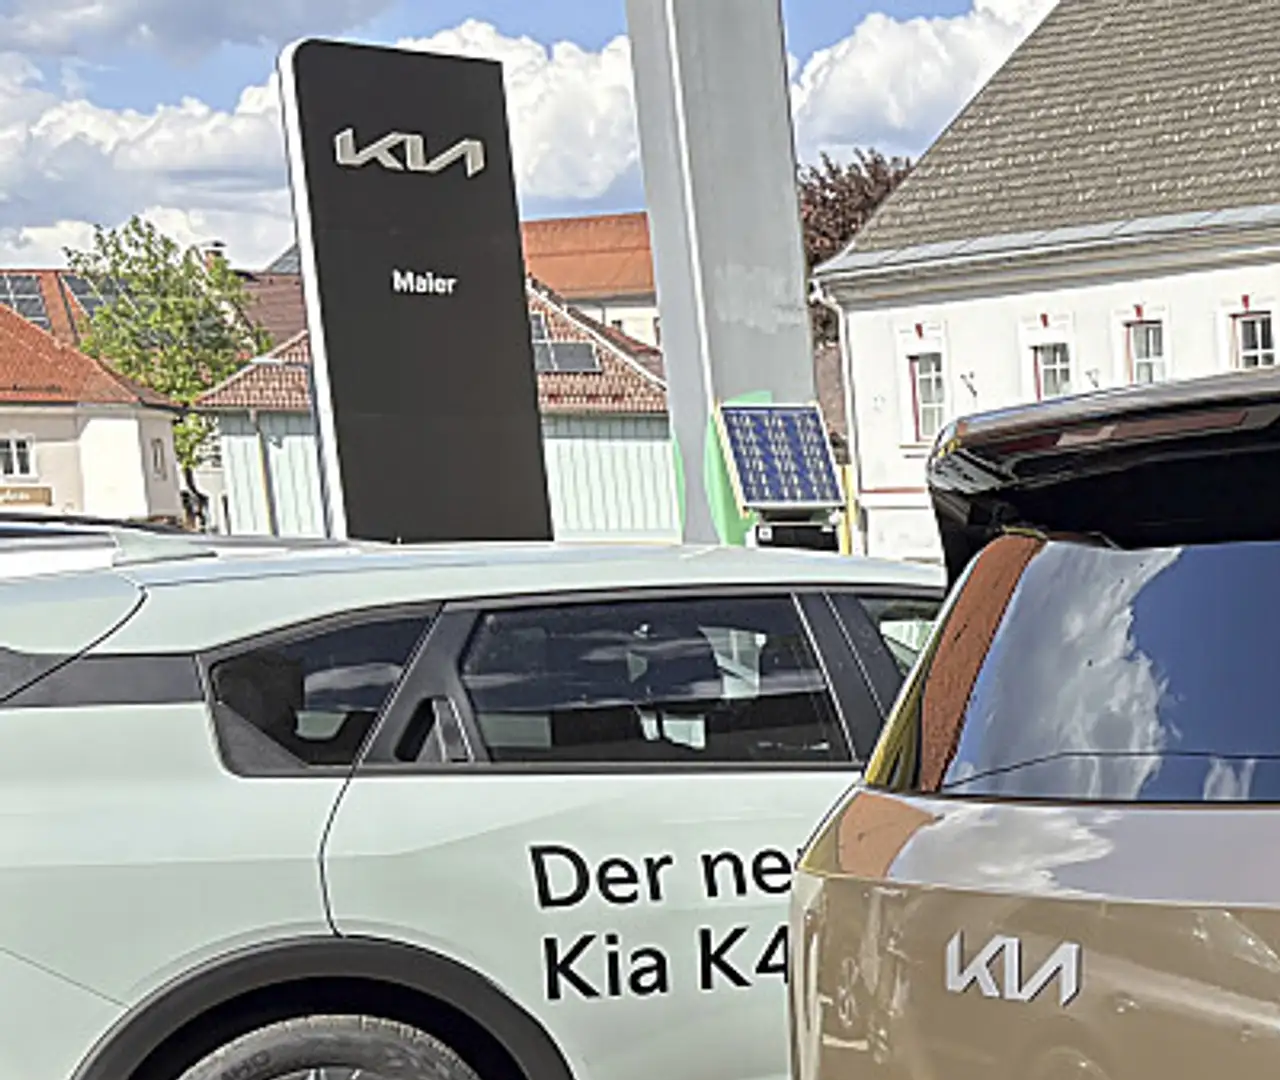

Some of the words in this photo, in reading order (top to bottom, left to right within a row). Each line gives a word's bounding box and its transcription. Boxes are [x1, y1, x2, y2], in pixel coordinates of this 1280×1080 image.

[335, 127, 485, 178] KIA
[392, 269, 457, 294] Maier
[528, 844, 674, 909] Der
[701, 848, 803, 897] ne
[543, 933, 668, 1001] Kia
[699, 924, 789, 990] K4
[946, 928, 1083, 1008] KIA
